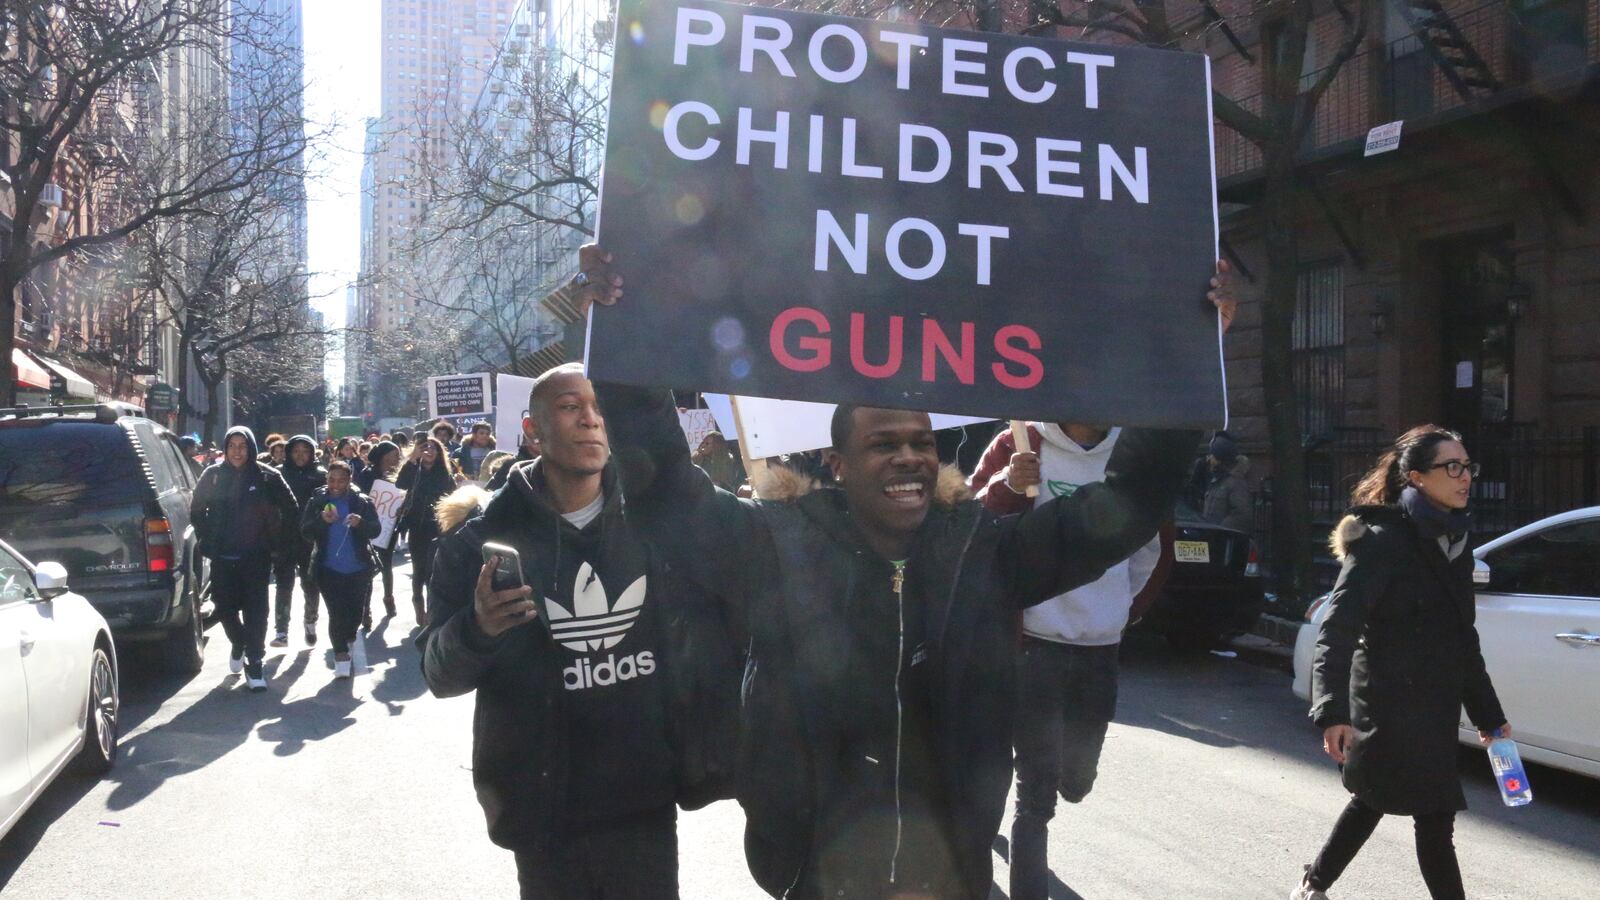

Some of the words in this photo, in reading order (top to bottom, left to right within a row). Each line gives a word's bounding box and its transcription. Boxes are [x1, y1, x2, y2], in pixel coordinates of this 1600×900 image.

[673, 7, 1115, 109] PROTECT
[663, 101, 1149, 204] CHILDREN
[815, 210, 1009, 285] NOT
[771, 308, 1043, 388] GUNS
[437, 393, 466, 401] OVERRULE
[687, 411, 716, 430] YSSA
[563, 650, 656, 691] didas
